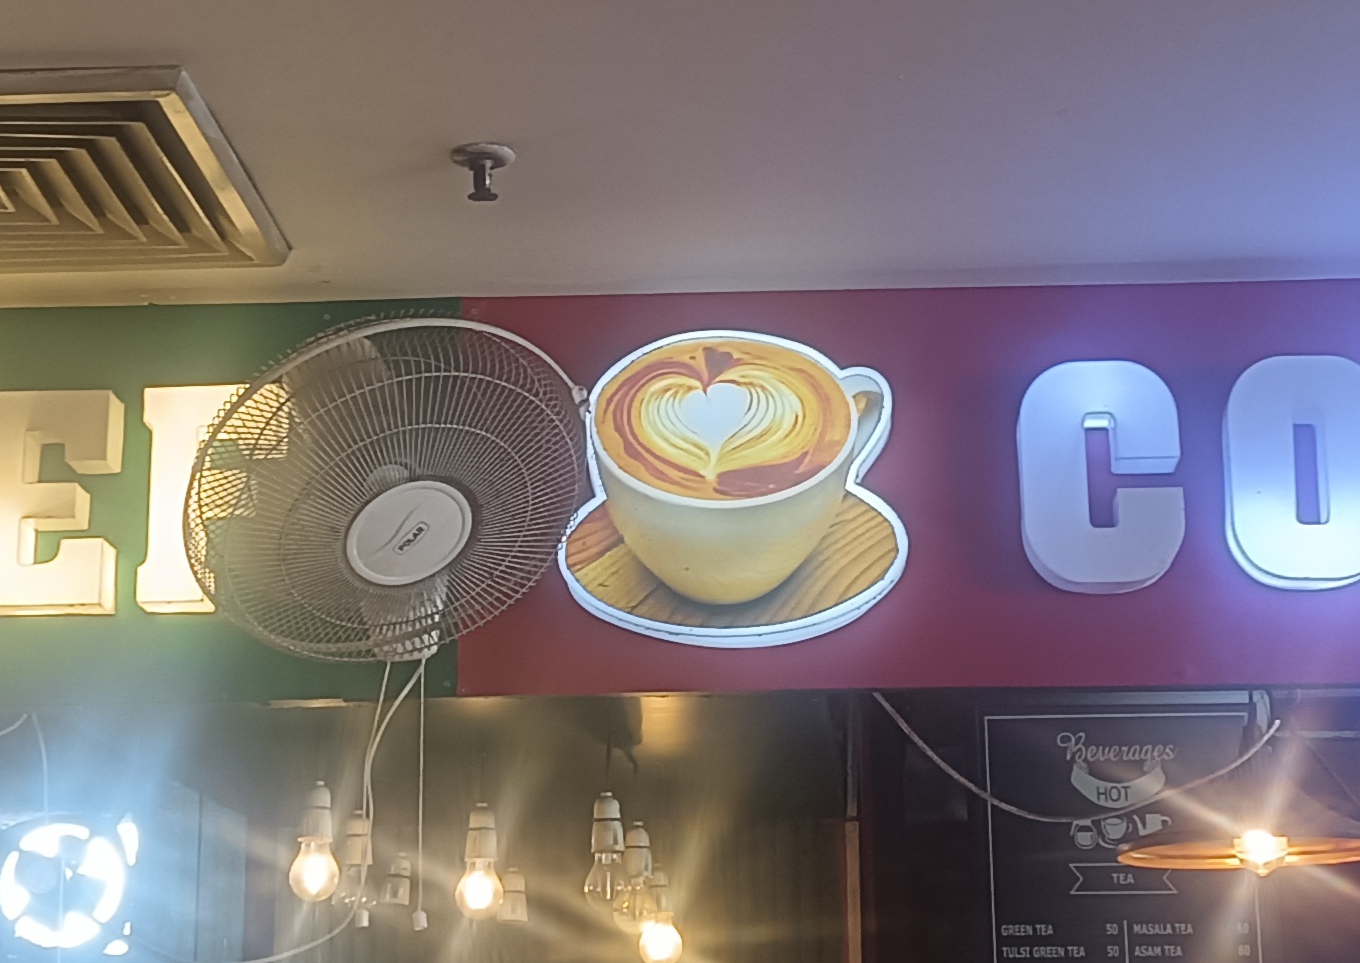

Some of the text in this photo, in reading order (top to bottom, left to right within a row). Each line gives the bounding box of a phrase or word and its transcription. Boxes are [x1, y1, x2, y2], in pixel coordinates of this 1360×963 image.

[397, 526, 425, 551] POLAR
[1057, 731, 1176, 764] Beverages
[1097, 786, 1131, 803] HOT
[1112, 873, 1134, 884] TEA
[1001, 923, 1118, 936] GREEN TEA 50
[1133, 923, 1173, 935] MASALA
[1174, 923, 1194, 934] TEA
[1002, 945, 1119, 958] TULSI GREEN TEA 50
[1134, 946, 1162, 957] ASAM
[1163, 945, 1183, 956] TEA
